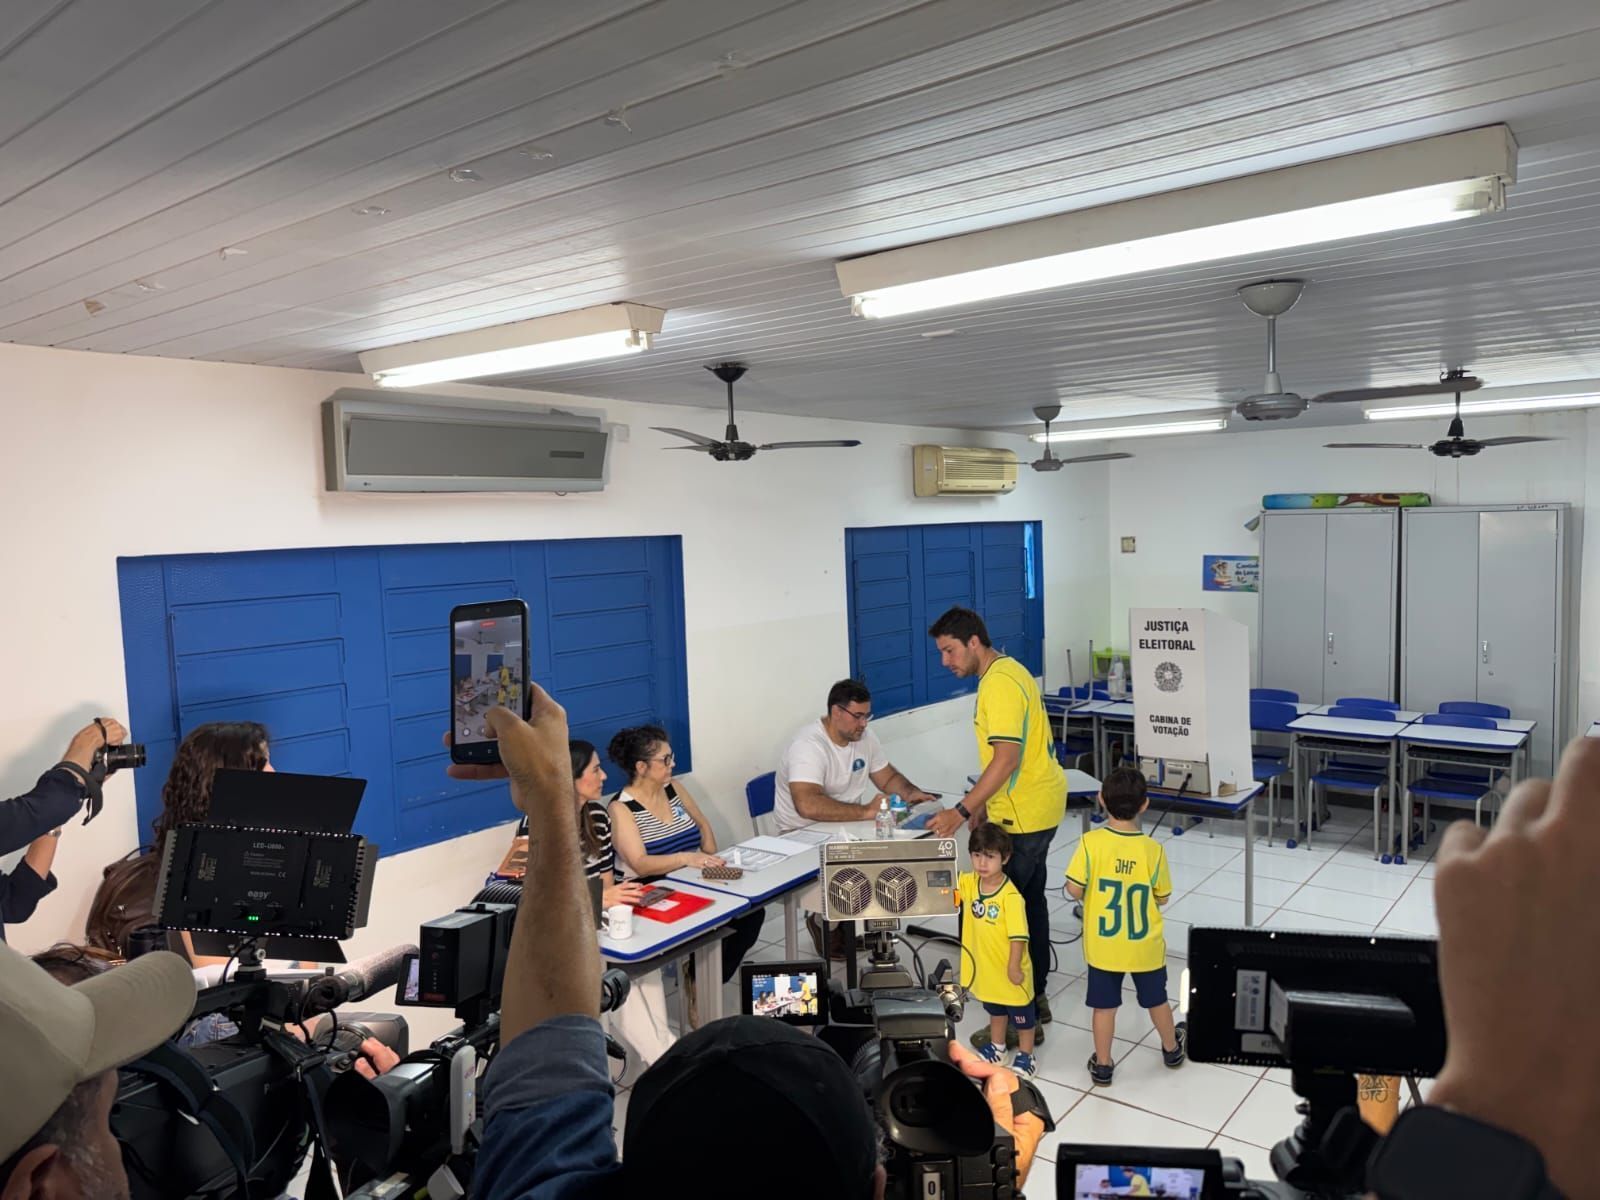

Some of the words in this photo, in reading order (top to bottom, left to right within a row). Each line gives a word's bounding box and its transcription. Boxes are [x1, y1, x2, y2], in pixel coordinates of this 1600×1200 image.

[1144, 620, 1189, 635] JUSTIÇA
[1138, 638, 1197, 651] ELEITORAL
[1149, 714, 1179, 725] CABINA
[1180, 716, 1192, 726] DE
[1152, 725, 1190, 737] VOTAÇÃO
[938, 841, 953, 855] 40
[971, 899, 985, 916] 30
[1098, 878, 1150, 940] 30
